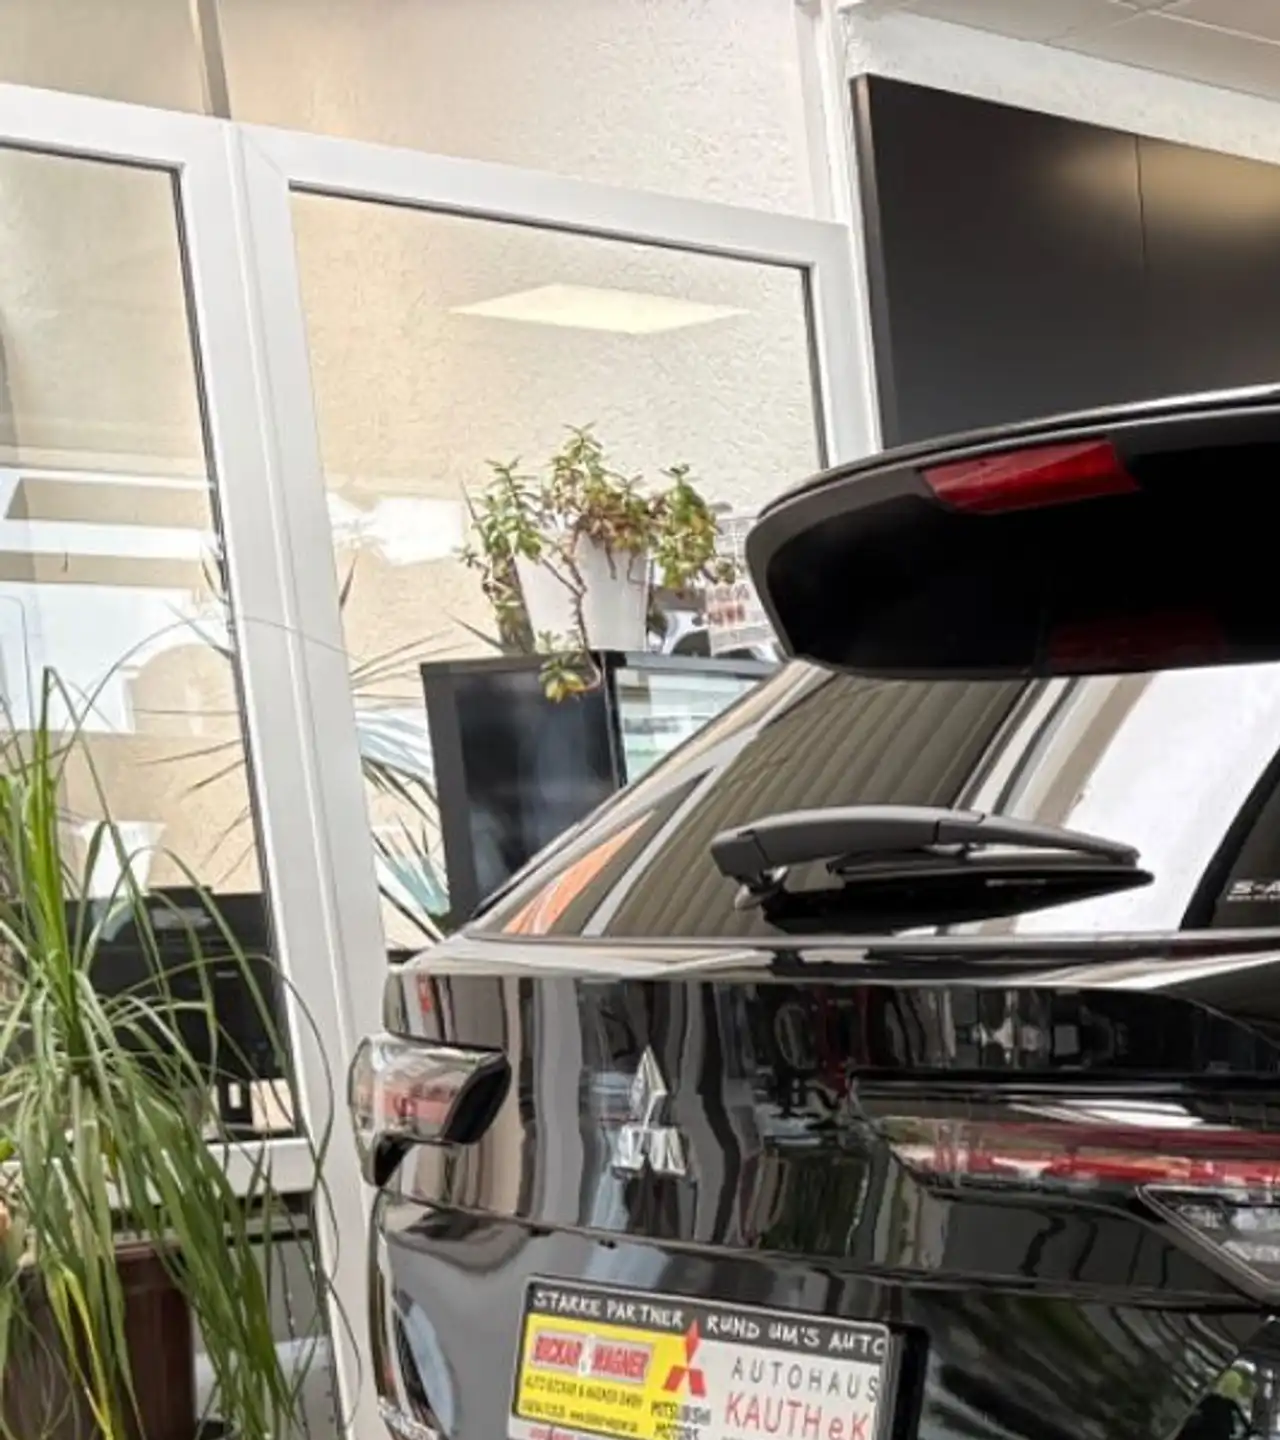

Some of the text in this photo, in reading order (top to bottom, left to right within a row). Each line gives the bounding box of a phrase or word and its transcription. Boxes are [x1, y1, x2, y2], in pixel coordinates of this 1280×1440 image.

[533, 1290, 601, 1318] STARKE
[605, 1299, 685, 1329] PARTNER
[706, 1314, 761, 1340] RUND
[767, 1322, 821, 1348] UM'S
[730, 1355, 882, 1403] AUTOHAUS
[724, 1391, 824, 1440] KAUTH
